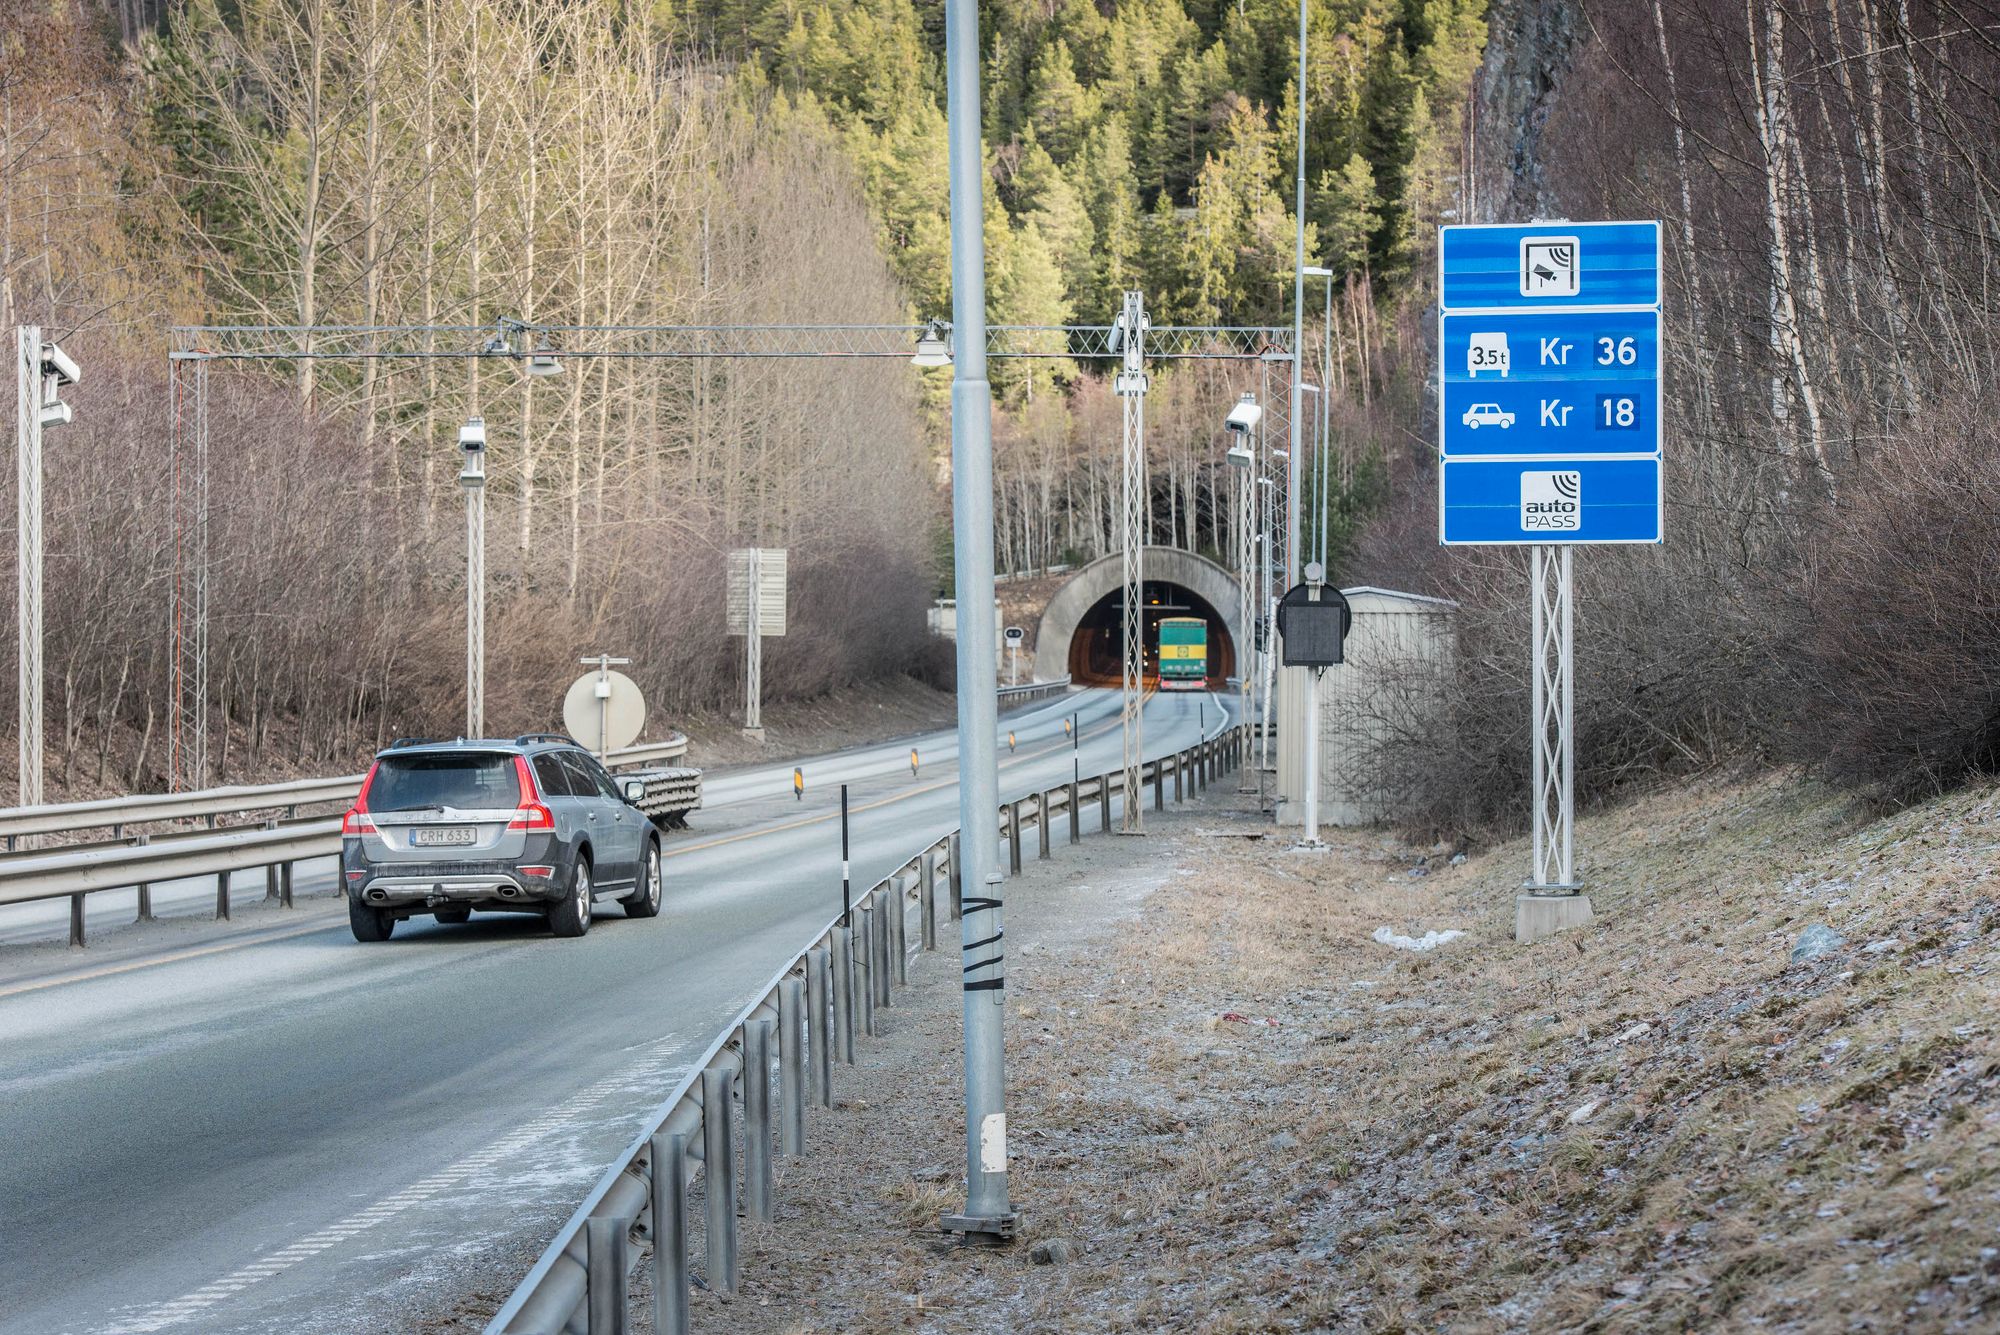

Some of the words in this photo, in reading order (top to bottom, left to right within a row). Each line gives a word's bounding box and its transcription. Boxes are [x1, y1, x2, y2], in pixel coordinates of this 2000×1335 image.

[1540, 337, 1574, 365] Kr
[1597, 337, 1637, 366] 36
[1540, 399, 1574, 427] Kr
[1603, 398, 1635, 427] 18
[1526, 499, 1576, 513] auto
[1526, 515, 1576, 528] PASS
[420, 830, 444, 842] CRH
[447, 829, 471, 841] 633
